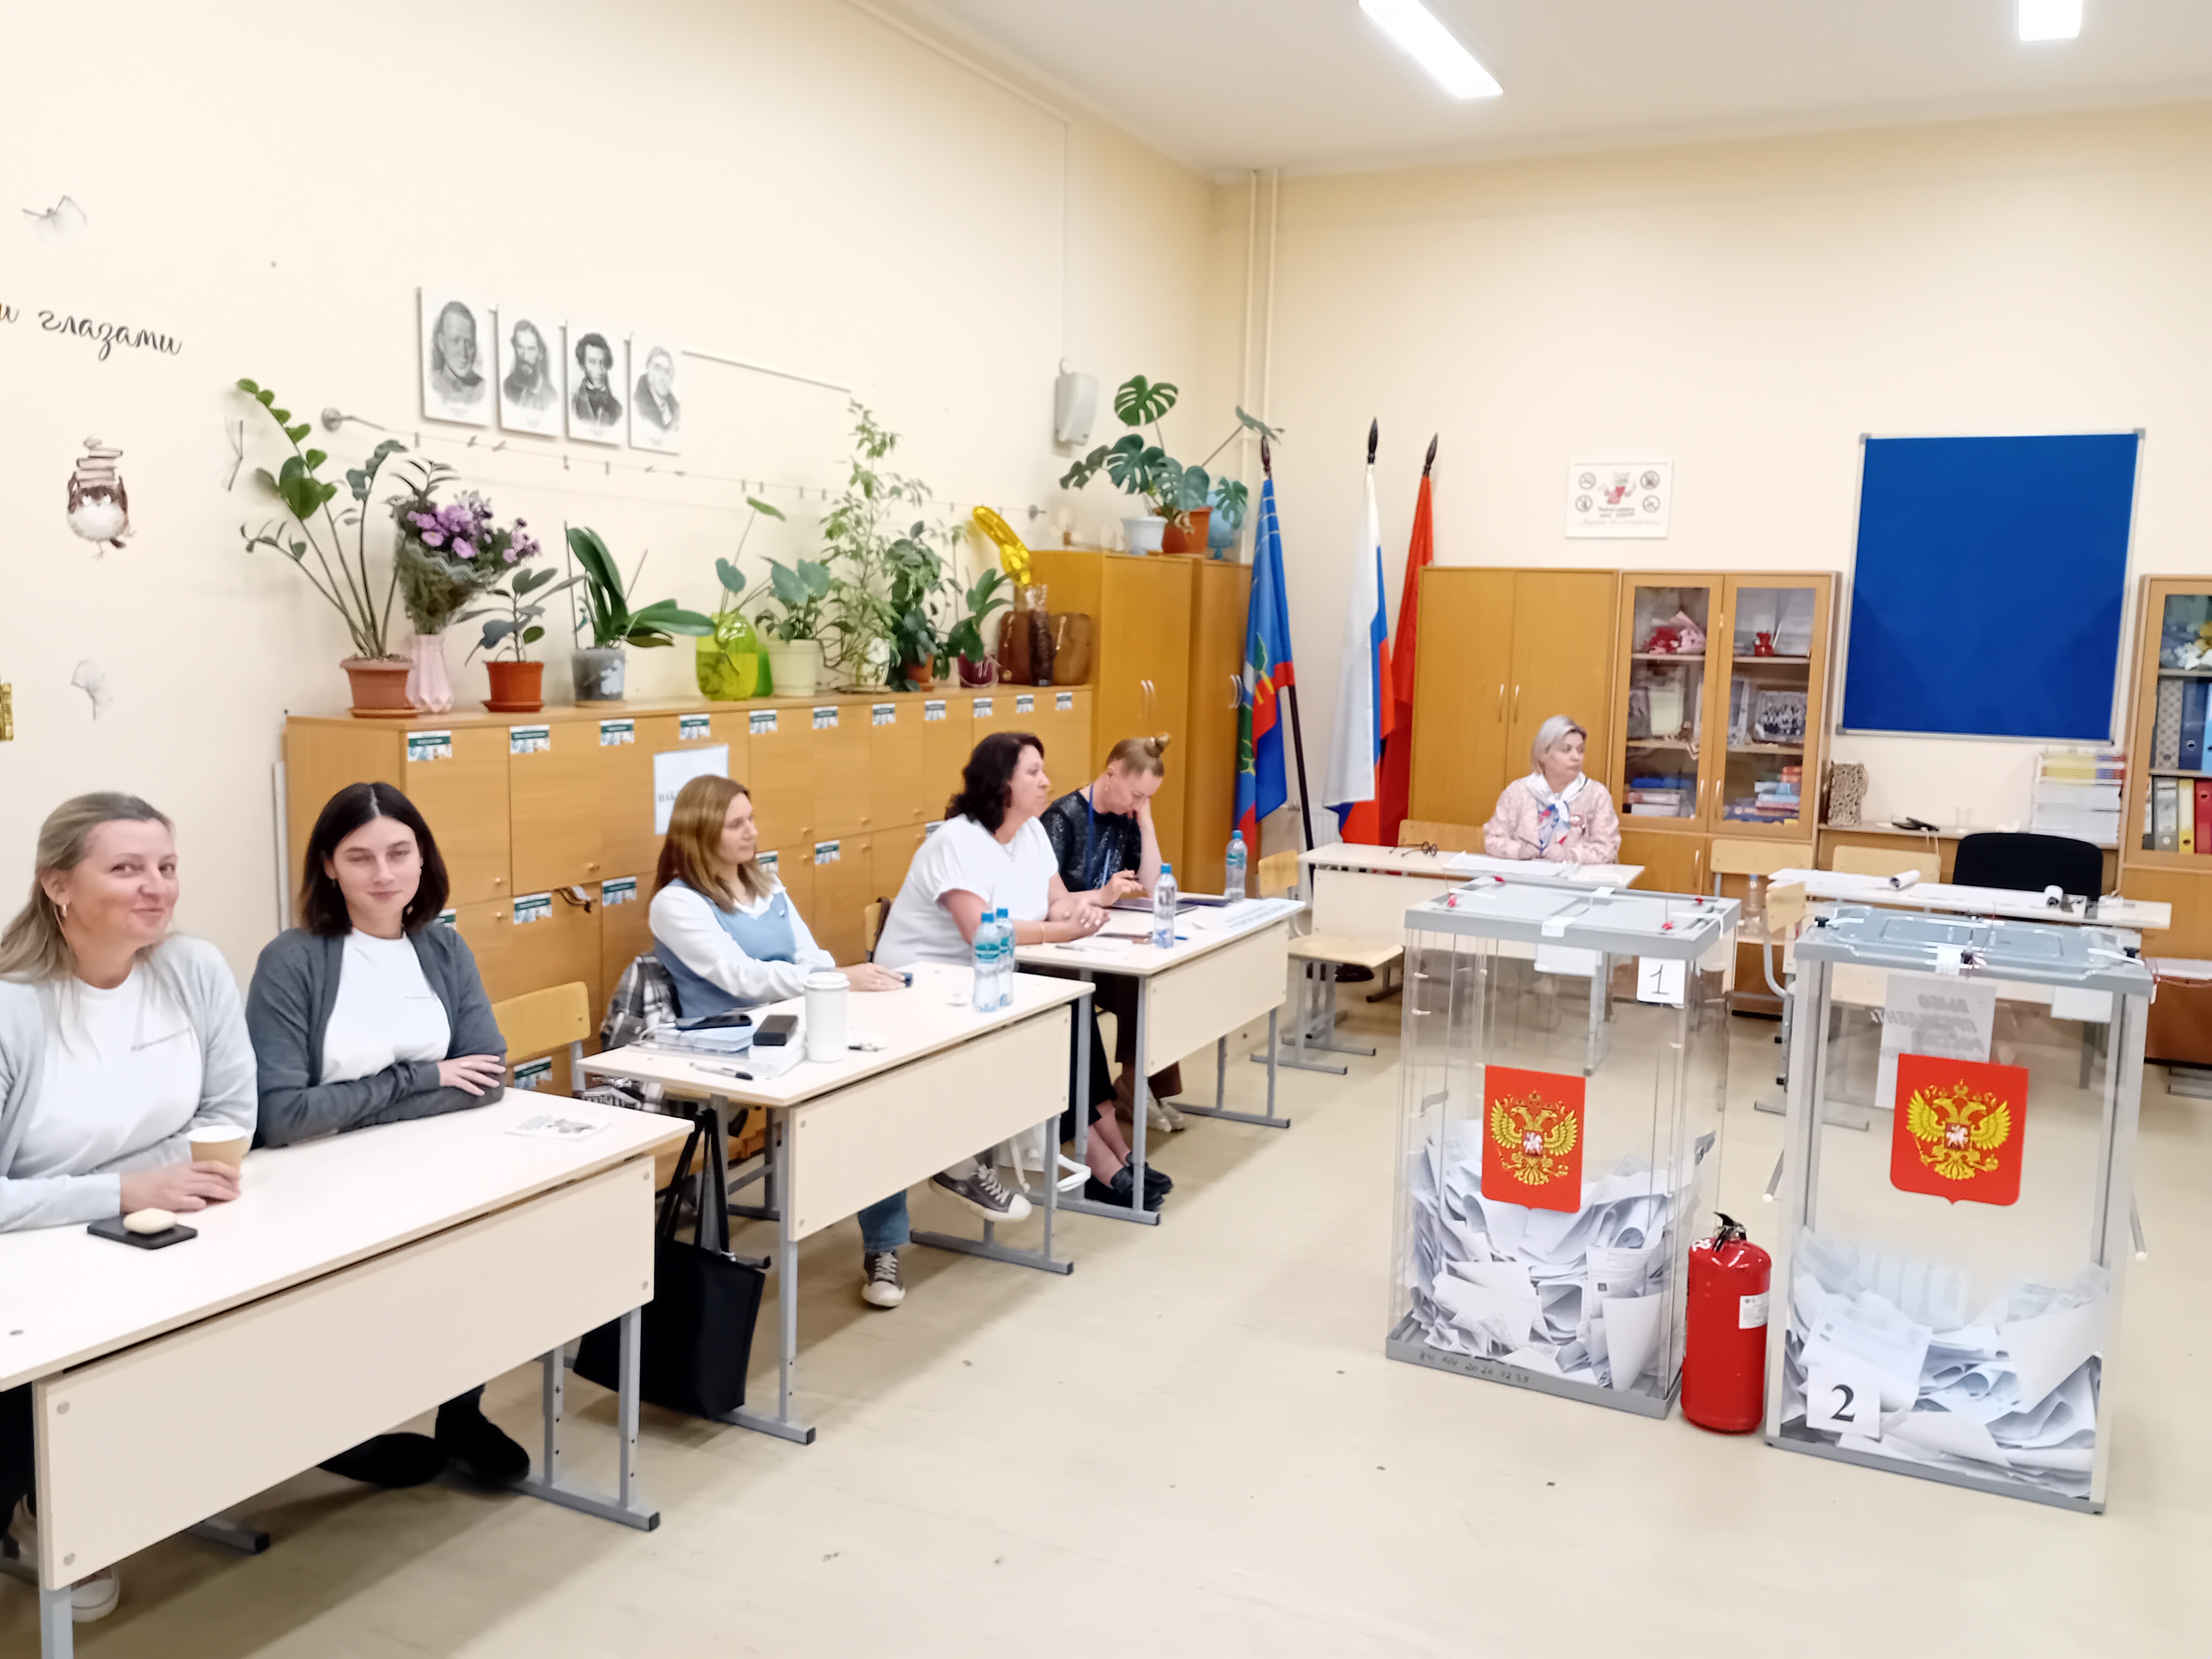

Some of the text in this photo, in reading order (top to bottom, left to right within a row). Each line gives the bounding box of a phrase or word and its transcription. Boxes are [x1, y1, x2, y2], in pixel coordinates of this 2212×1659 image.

[37, 310, 183, 362] глазами
[658, 790, 677, 803] НАБ
[1649, 963, 1670, 996] 1
[1830, 1384, 1855, 1423] 2
